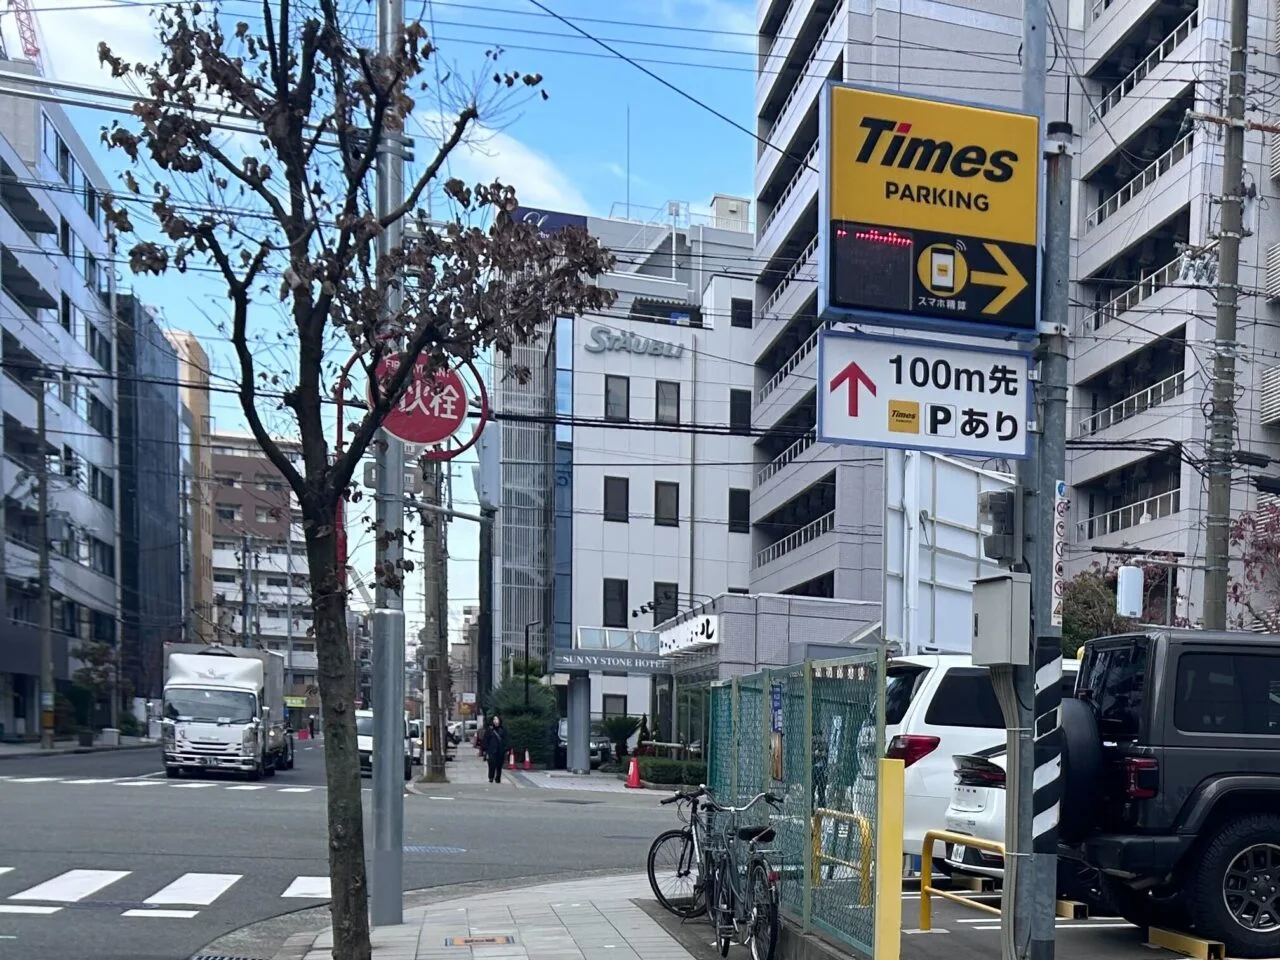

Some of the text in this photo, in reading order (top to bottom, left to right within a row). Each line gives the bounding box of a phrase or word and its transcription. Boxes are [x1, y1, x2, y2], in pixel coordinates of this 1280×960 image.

[856, 117, 1018, 182] Times
[885, 181, 989, 212] PARKING
[889, 354, 1018, 396] 100m先
